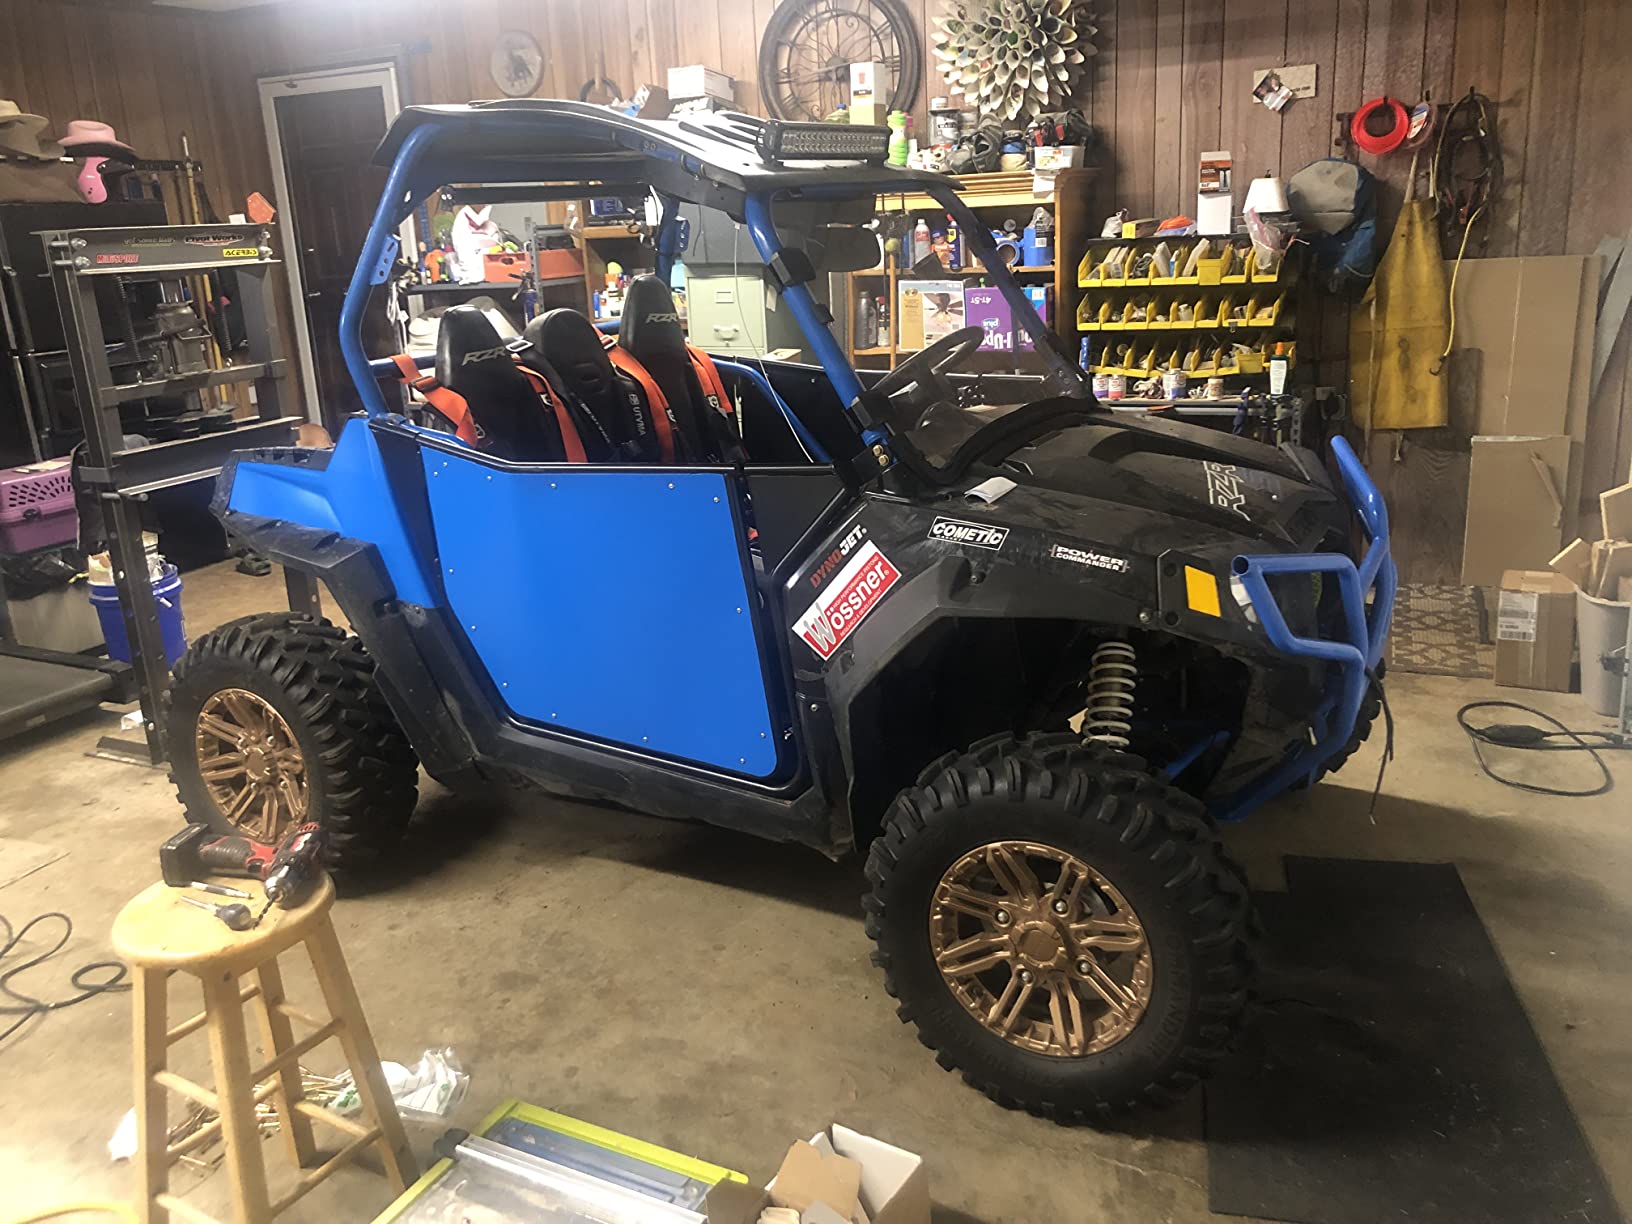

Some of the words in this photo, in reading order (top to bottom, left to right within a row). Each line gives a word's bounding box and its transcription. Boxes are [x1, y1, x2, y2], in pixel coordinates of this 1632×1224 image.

[1203, 461, 1251, 521] RZR
[933, 522, 1003, 544] COMETIC
[1056, 546, 1124, 566] POWER
[1056, 552, 1120, 571] COMMANDER
